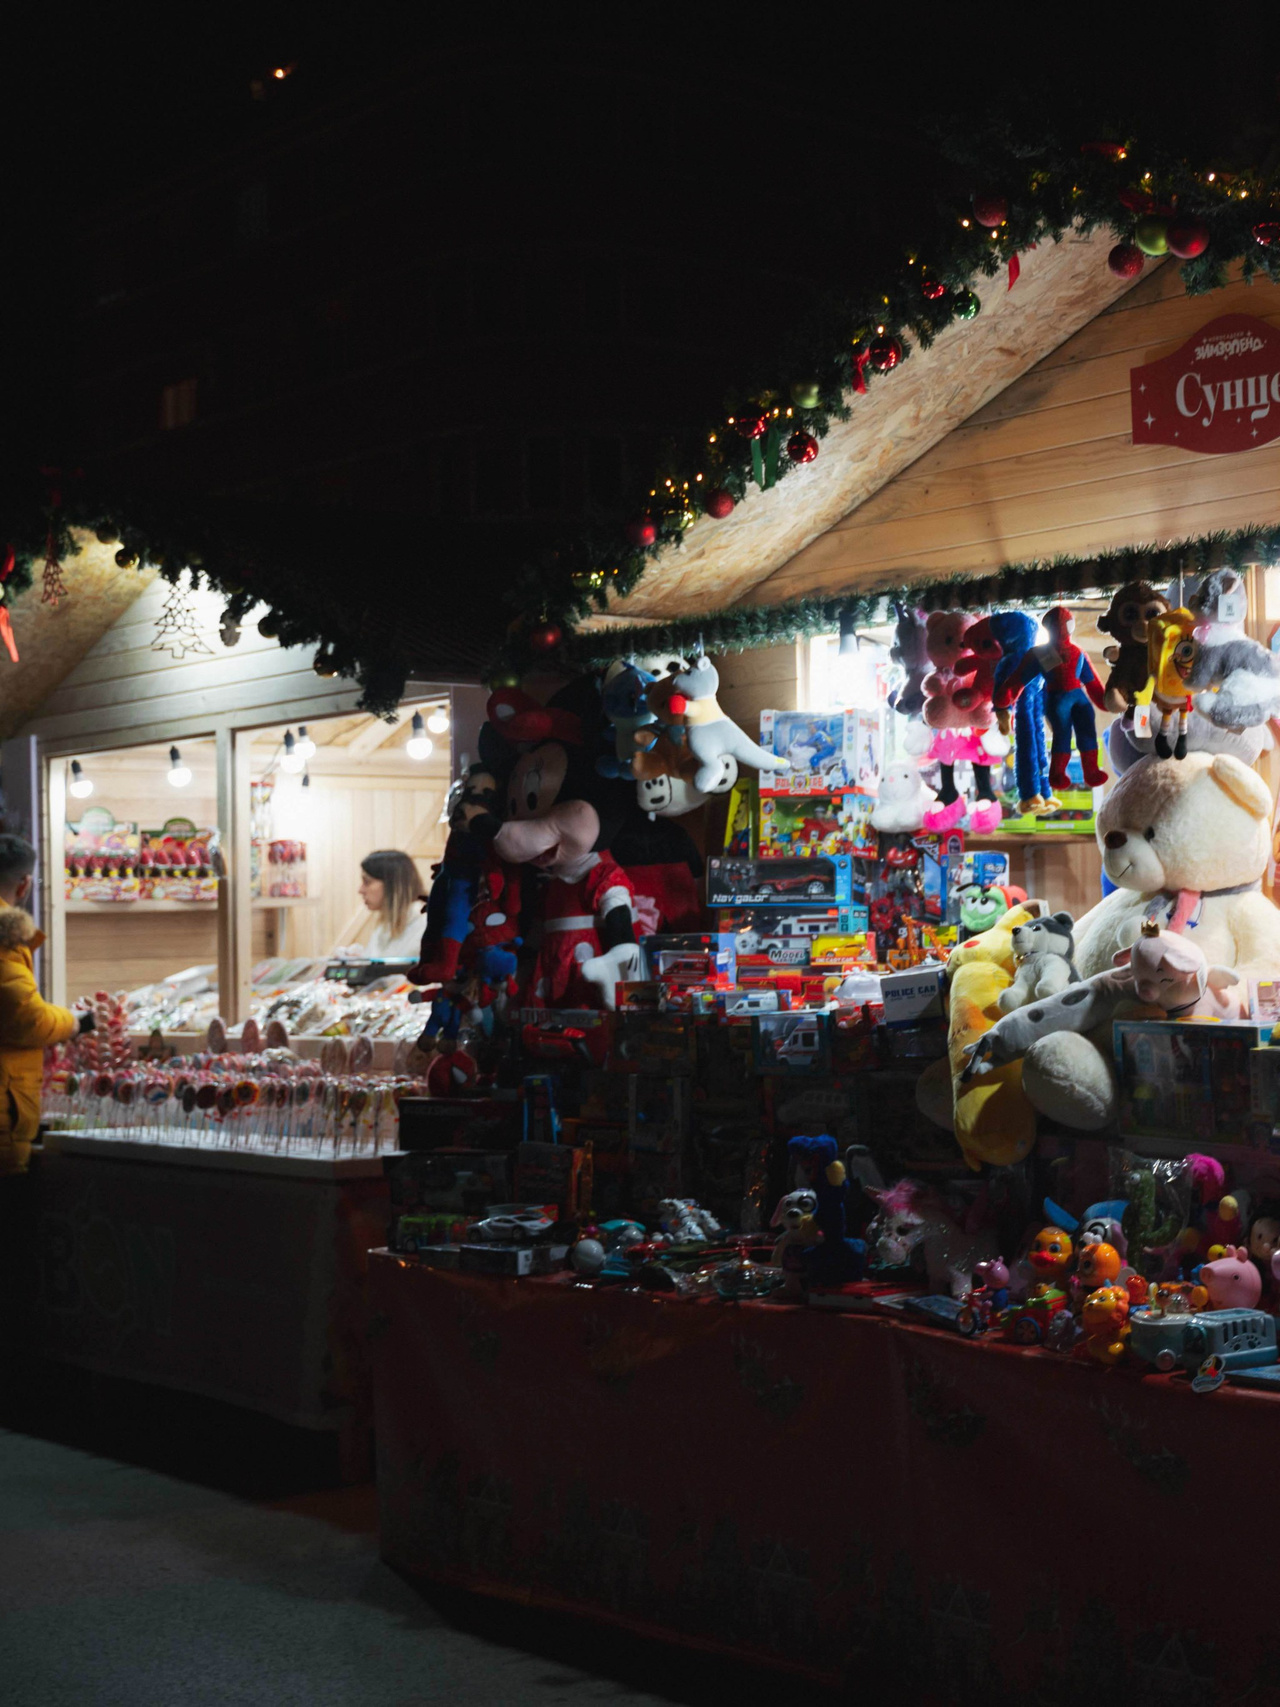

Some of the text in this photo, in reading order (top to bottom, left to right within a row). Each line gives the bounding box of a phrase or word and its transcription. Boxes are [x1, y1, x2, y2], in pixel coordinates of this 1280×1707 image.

[712, 893, 769, 905] Navigator
[885, 984, 936, 998] POLICE CAR
